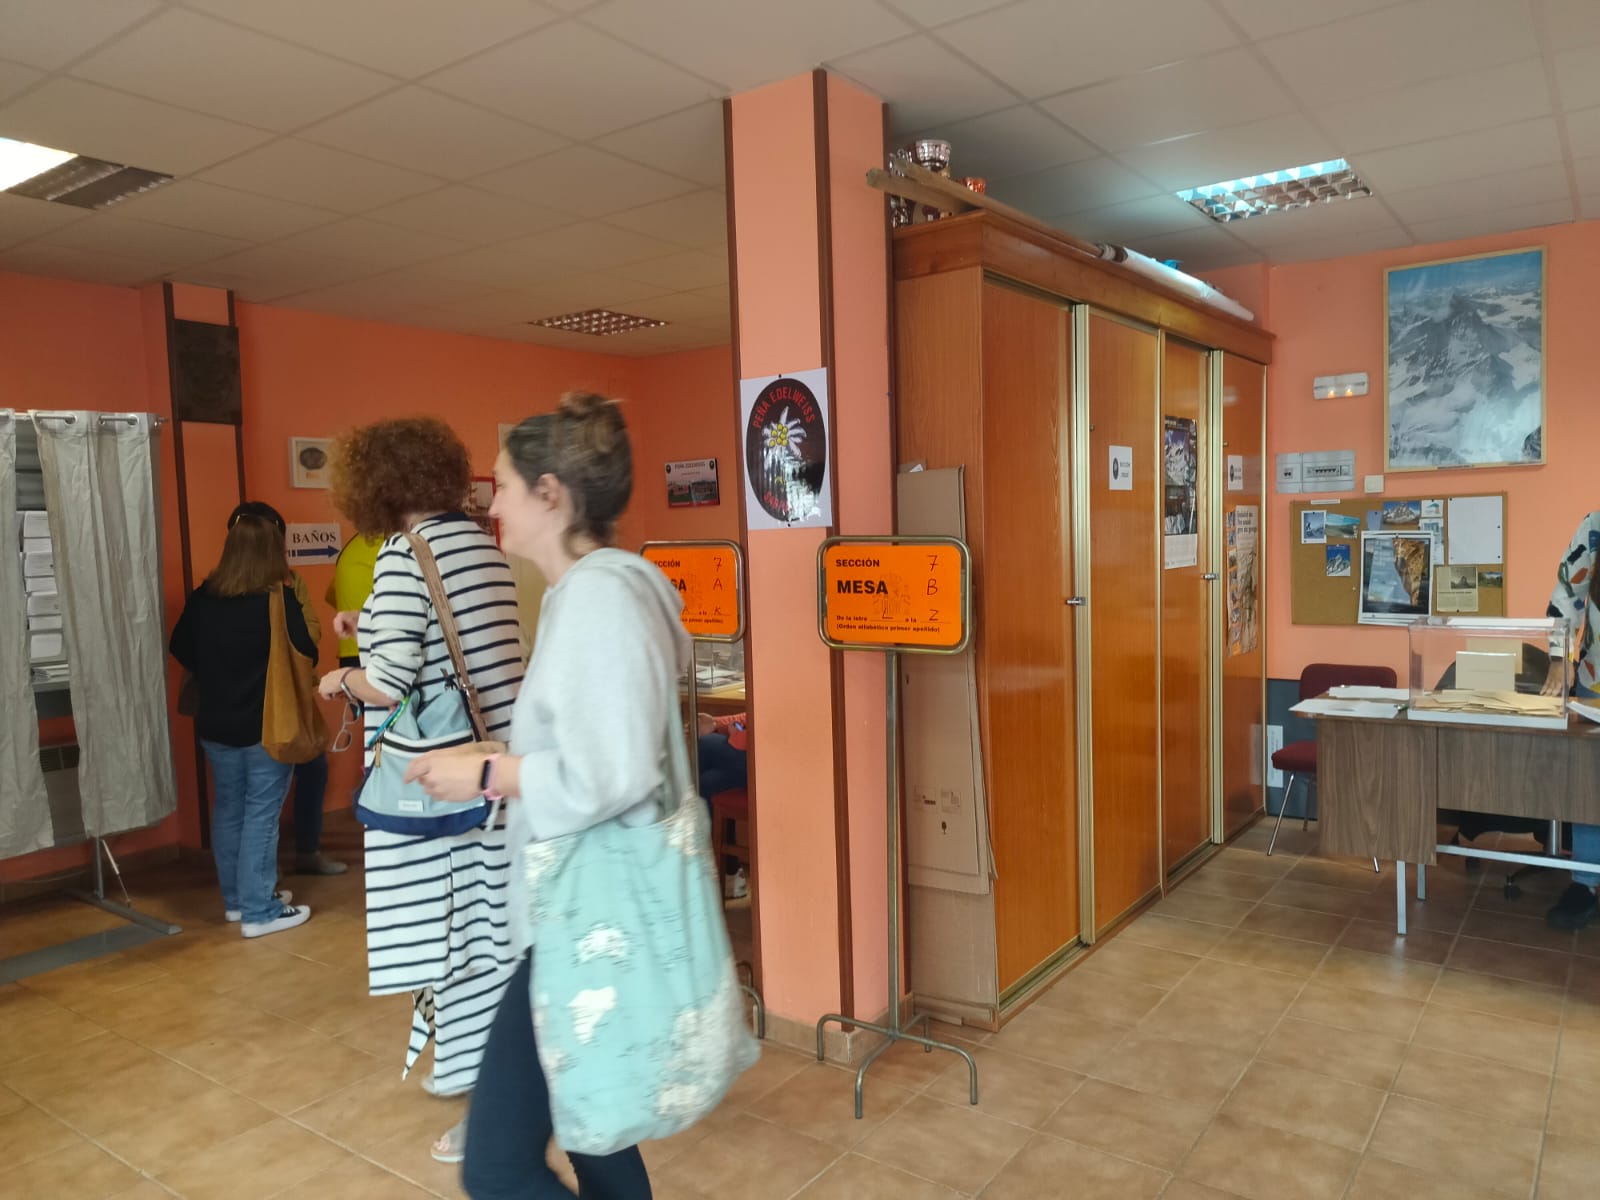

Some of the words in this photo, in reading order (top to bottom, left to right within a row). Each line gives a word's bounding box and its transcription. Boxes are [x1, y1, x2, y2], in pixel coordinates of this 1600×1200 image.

[769, 386, 815, 423] EDELWEISS
[292, 530, 336, 544] BAÑOS
[713, 557, 722, 572] 7
[836, 558, 880, 567] SECCIÓN
[928, 555, 938, 571] 7
[713, 578, 723, 592] A
[837, 580, 888, 594] MESA
[927, 578, 938, 595] B
